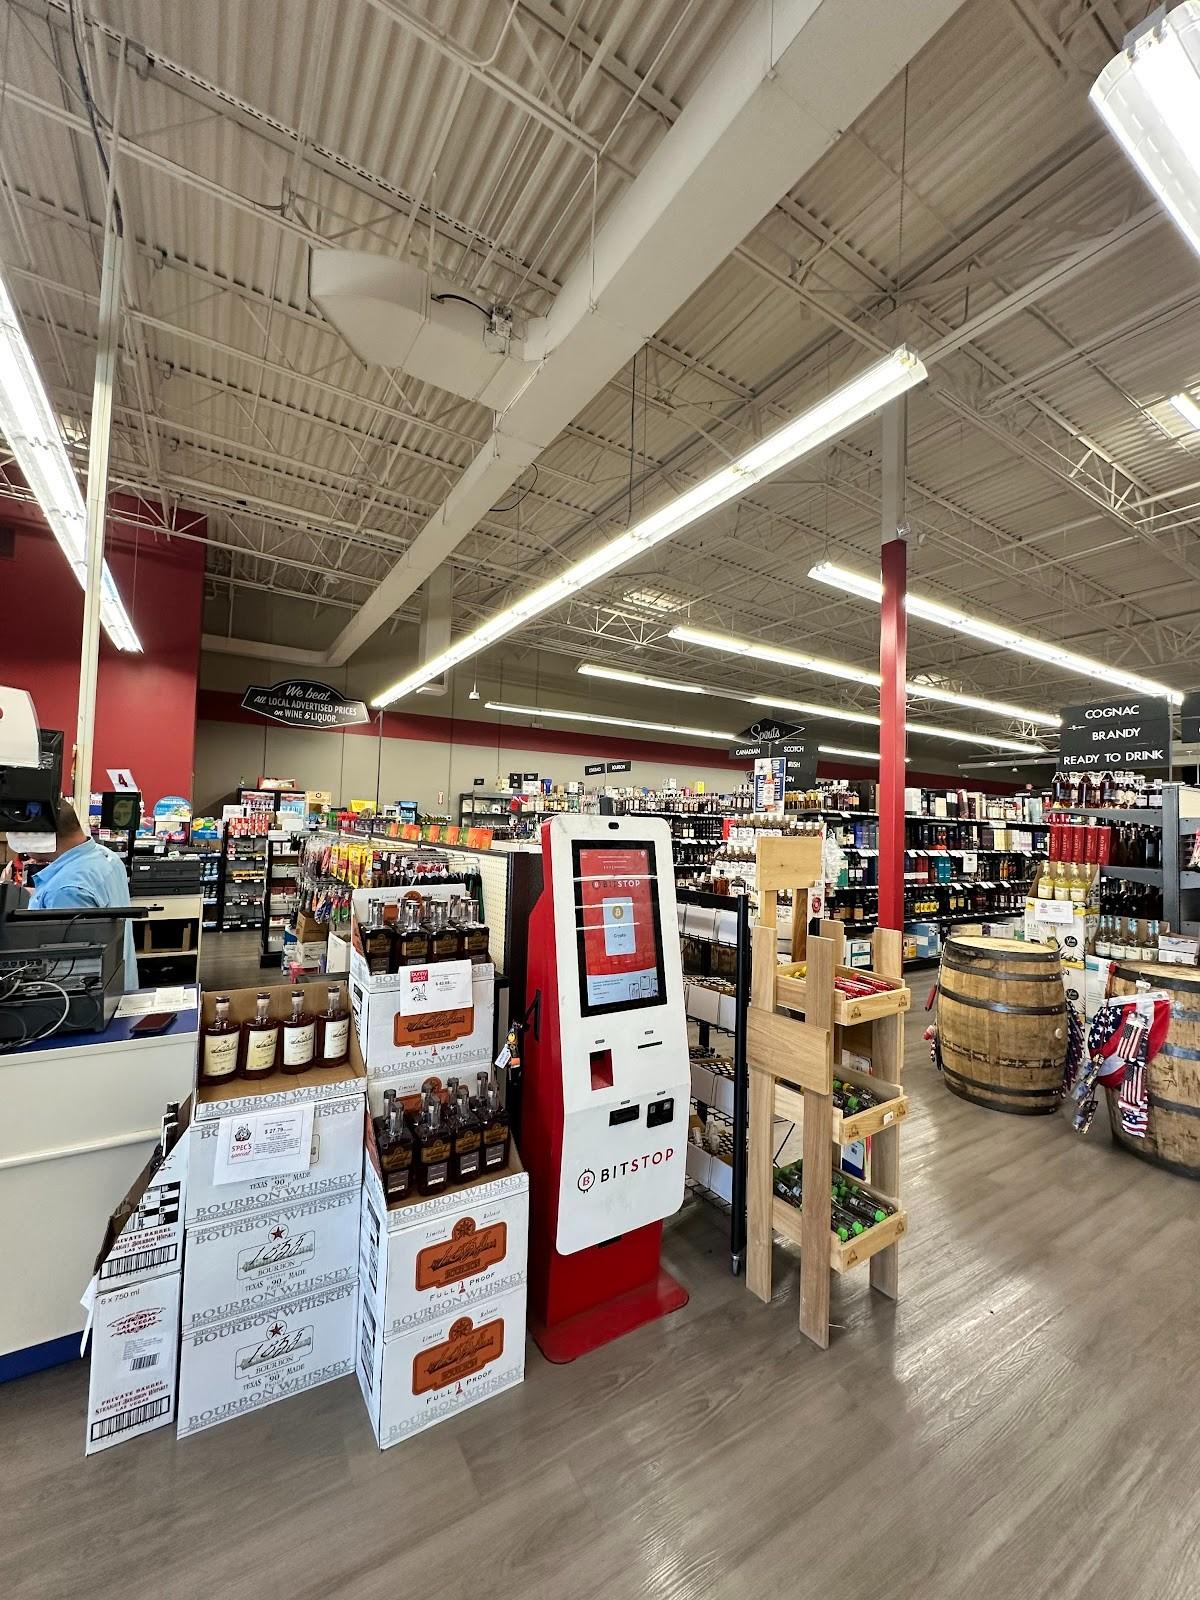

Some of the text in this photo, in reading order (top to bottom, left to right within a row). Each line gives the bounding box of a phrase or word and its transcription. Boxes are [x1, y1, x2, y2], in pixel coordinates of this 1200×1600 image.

[285, 684, 331, 701] We beat
[254, 695, 357, 716] All LOCAL ADVERTISED PRICES
[1084, 704, 1140, 719] COGNAC
[284, 709, 303, 719] WINE
[303, 711, 311, 720] &
[311, 712, 338, 723] LIQUOR.
[1092, 727, 1141, 741] BRANDY
[735, 748, 761, 756] CANADIAN
[783, 745, 804, 753] SCOTCH
[1063, 749, 1164, 765] READY TO DRINK
[118, 773, 128, 788] 4
[441, 1043, 464, 1051] PROOF
[373, 1047, 490, 1074] BOURBON WHISKEY
[205, 1077, 361, 1112] BOURBON WHISKEY
[231, 1143, 252, 1152] SPEC'S
[600, 1147, 674, 1183] BITSTOP
[274, 1178, 285, 1186] 90
[195, 1187, 282, 1218] BOURBON
[284, 1172, 357, 1196] WHISKEY
[393, 1173, 524, 1221] BOURBON WHISKEY
[196, 1195, 355, 1245] BOURBON WHISKEY
[144, 1227, 171, 1236] BARREL
[138, 1242, 157, 1250] VEGAS
[257, 1260, 295, 1276] BOURBON
[245, 1281, 264, 1292] TEXAS
[429, 1271, 496, 1301] FULL PROOF
[114, 1292, 129, 1301] 750
[130, 1288, 140, 1297] ml
[191, 1266, 353, 1323] BOURBON WHISKEY
[392, 1270, 524, 1328] BOURBON WHISKEY
[133, 1316, 156, 1326] VEGAS
[192, 1287, 354, 1347] BOURBON WHISKEY
[255, 1356, 294, 1374] BOURBON
[242, 1378, 262, 1390] TEXAS
[269, 1374, 280, 1382] 90
[101, 1380, 164, 1406] PRIVATE BARREL
[188, 1357, 351, 1427] BOURBON WHISKEY
[426, 1369, 493, 1404] FULL PROOF
[95, 1400, 121, 1415] STRAIGHT
[115, 1397, 150, 1412] LAS VEGAS
[388, 1364, 522, 1436] BOURBON WHISKEY
